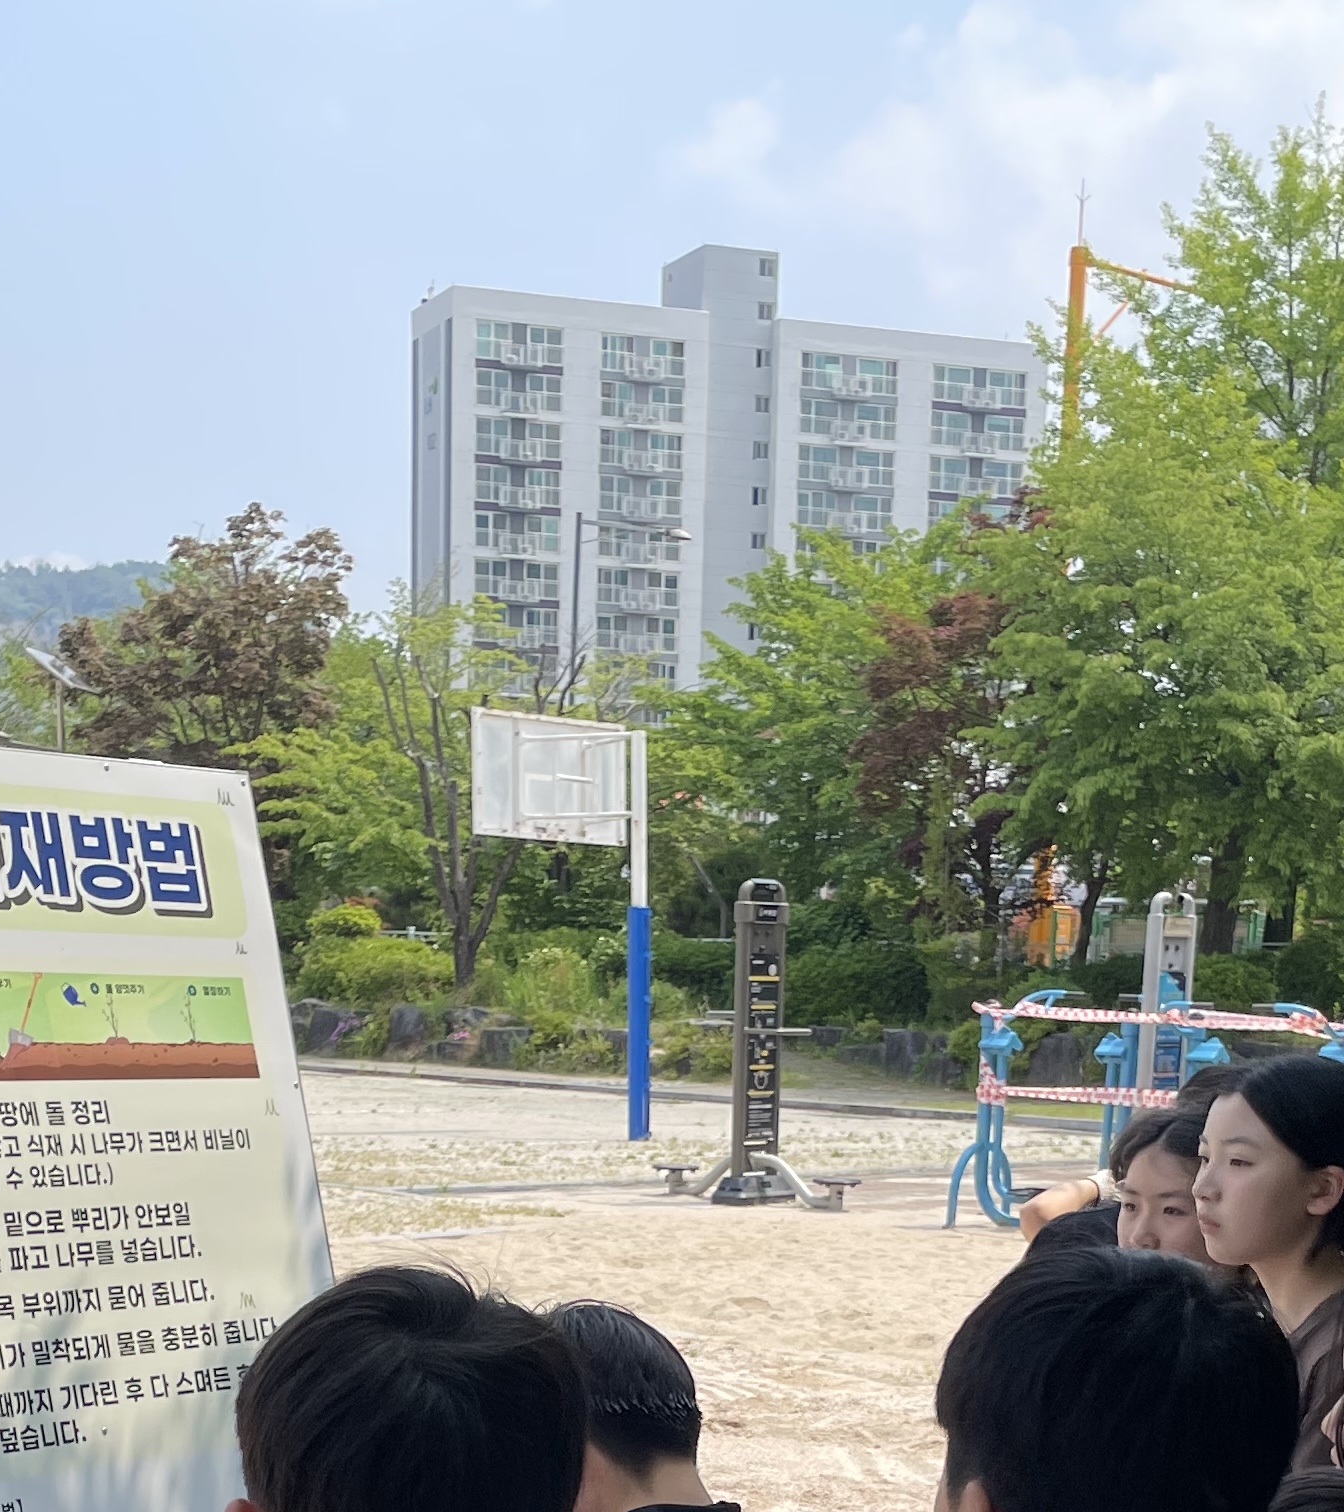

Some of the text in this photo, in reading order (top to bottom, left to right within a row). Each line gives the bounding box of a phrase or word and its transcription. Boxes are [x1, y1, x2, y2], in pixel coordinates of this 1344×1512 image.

[45, 1101, 66, 1126] 돌
[70, 1100, 111, 1125] 정리
[27, 1133, 64, 1157] 식재
[70, 1133, 87, 1156] 시
[90, 1131, 143, 1155] 나무가
[147, 1129, 199, 1152] 크면서
[202, 1128, 251, 1151] 비닐이
[6, 1167, 24, 1190] 수
[29, 1162, 114, 1188] 있습니다.)
[4, 1210, 66, 1238] 밑으로
[71, 1205, 129, 1233] 뿌리가
[135, 1202, 192, 1230] 안보일
[8, 1245, 50, 1272] 파고
[55, 1240, 115, 1268] 나무를
[120, 1234, 202, 1264] 넣습니다.
[21, 1287, 102, 1318] 부위까지
[107, 1283, 147, 1311] 묻어
[151, 1278, 216, 1307] 줍니다.
[31, 1334, 112, 1366] 밀착되게
[116, 1329, 157, 1357] 물을
[161, 1323, 219, 1352] 충분히
[59, 1379, 120, 1411] 기다린
[124, 1377, 145, 1403] 후
[149, 1373, 170, 1399] 다
[175, 1365, 232, 1397] 스며든
[0, 1419, 88, 1455] 덮습니다.
